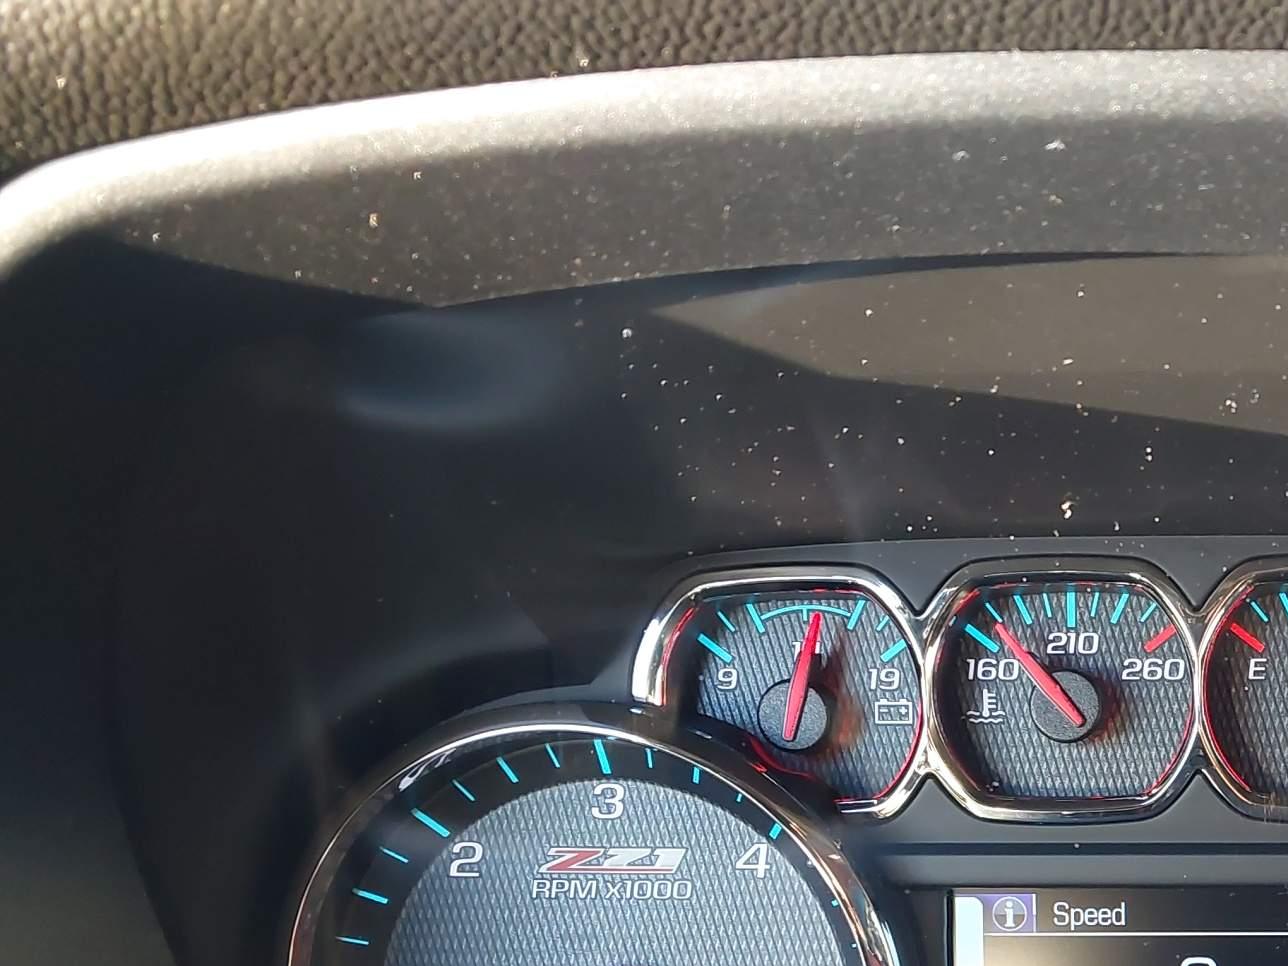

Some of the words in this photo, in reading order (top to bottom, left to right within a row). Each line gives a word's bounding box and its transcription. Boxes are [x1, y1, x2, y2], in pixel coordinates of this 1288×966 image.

[1047, 632, 1099, 655] 210
[716, 667, 739, 690] 9
[869, 667, 901, 690] 19
[967, 659, 1019, 682] 160
[1122, 659, 1185, 681] 260
[1248, 658, 1268, 681] E
[591, 783, 626, 820] 3
[449, 841, 484, 878] 2
[735, 843, 771, 879] 4
[532, 879, 597, 900] RPM
[1052, 902, 1127, 930] Speed
